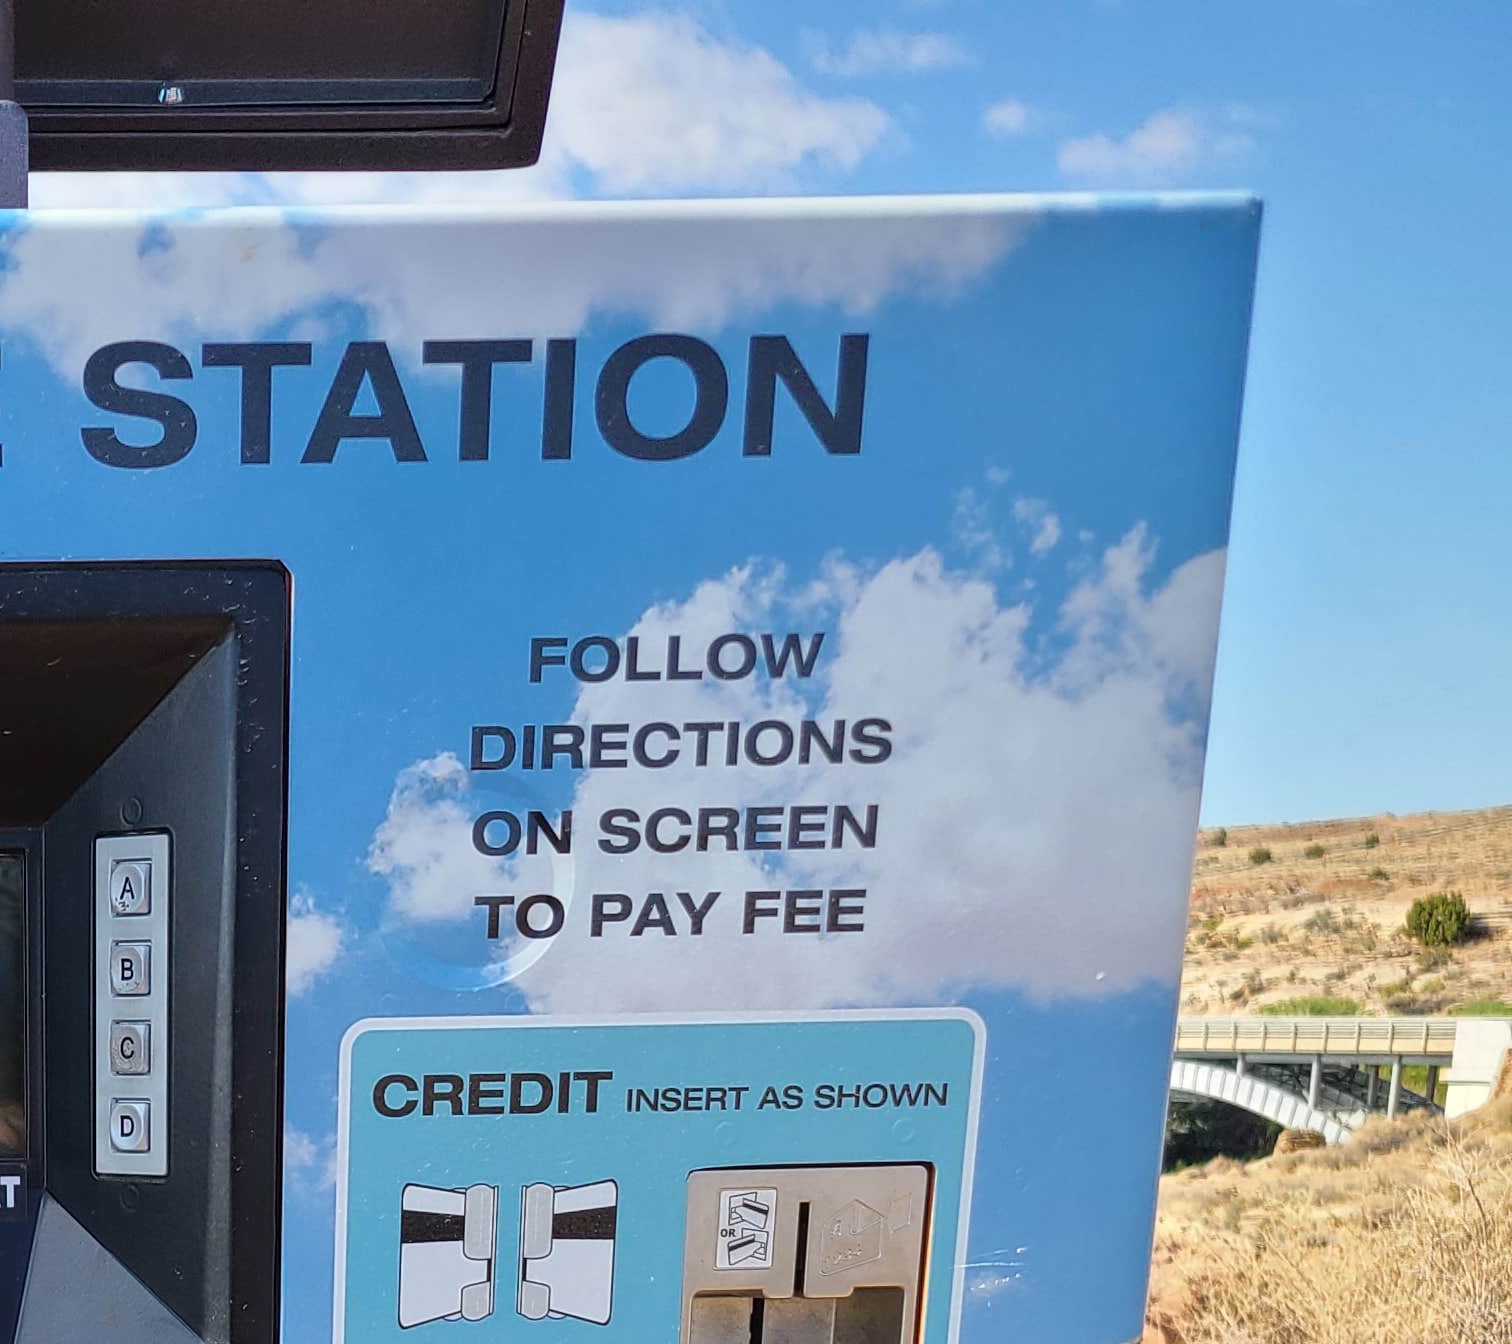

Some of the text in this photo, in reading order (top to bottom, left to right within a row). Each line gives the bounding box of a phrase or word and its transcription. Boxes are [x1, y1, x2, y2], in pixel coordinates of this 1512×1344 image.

[80, 332, 869, 469] STATION
[529, 632, 826, 684] FOLLOW
[470, 717, 893, 771] DIRECTIONS
[471, 804, 880, 856] ON SCREEN
[119, 875, 136, 901] A
[473, 889, 867, 940] TO PAY FEE
[120, 958, 135, 982] B
[120, 1036, 135, 1061] C
[372, 1071, 950, 1118] CREDIT INSERT AS SHOWN
[120, 1116, 135, 1139] D
[720, 1228, 737, 1238] OR
